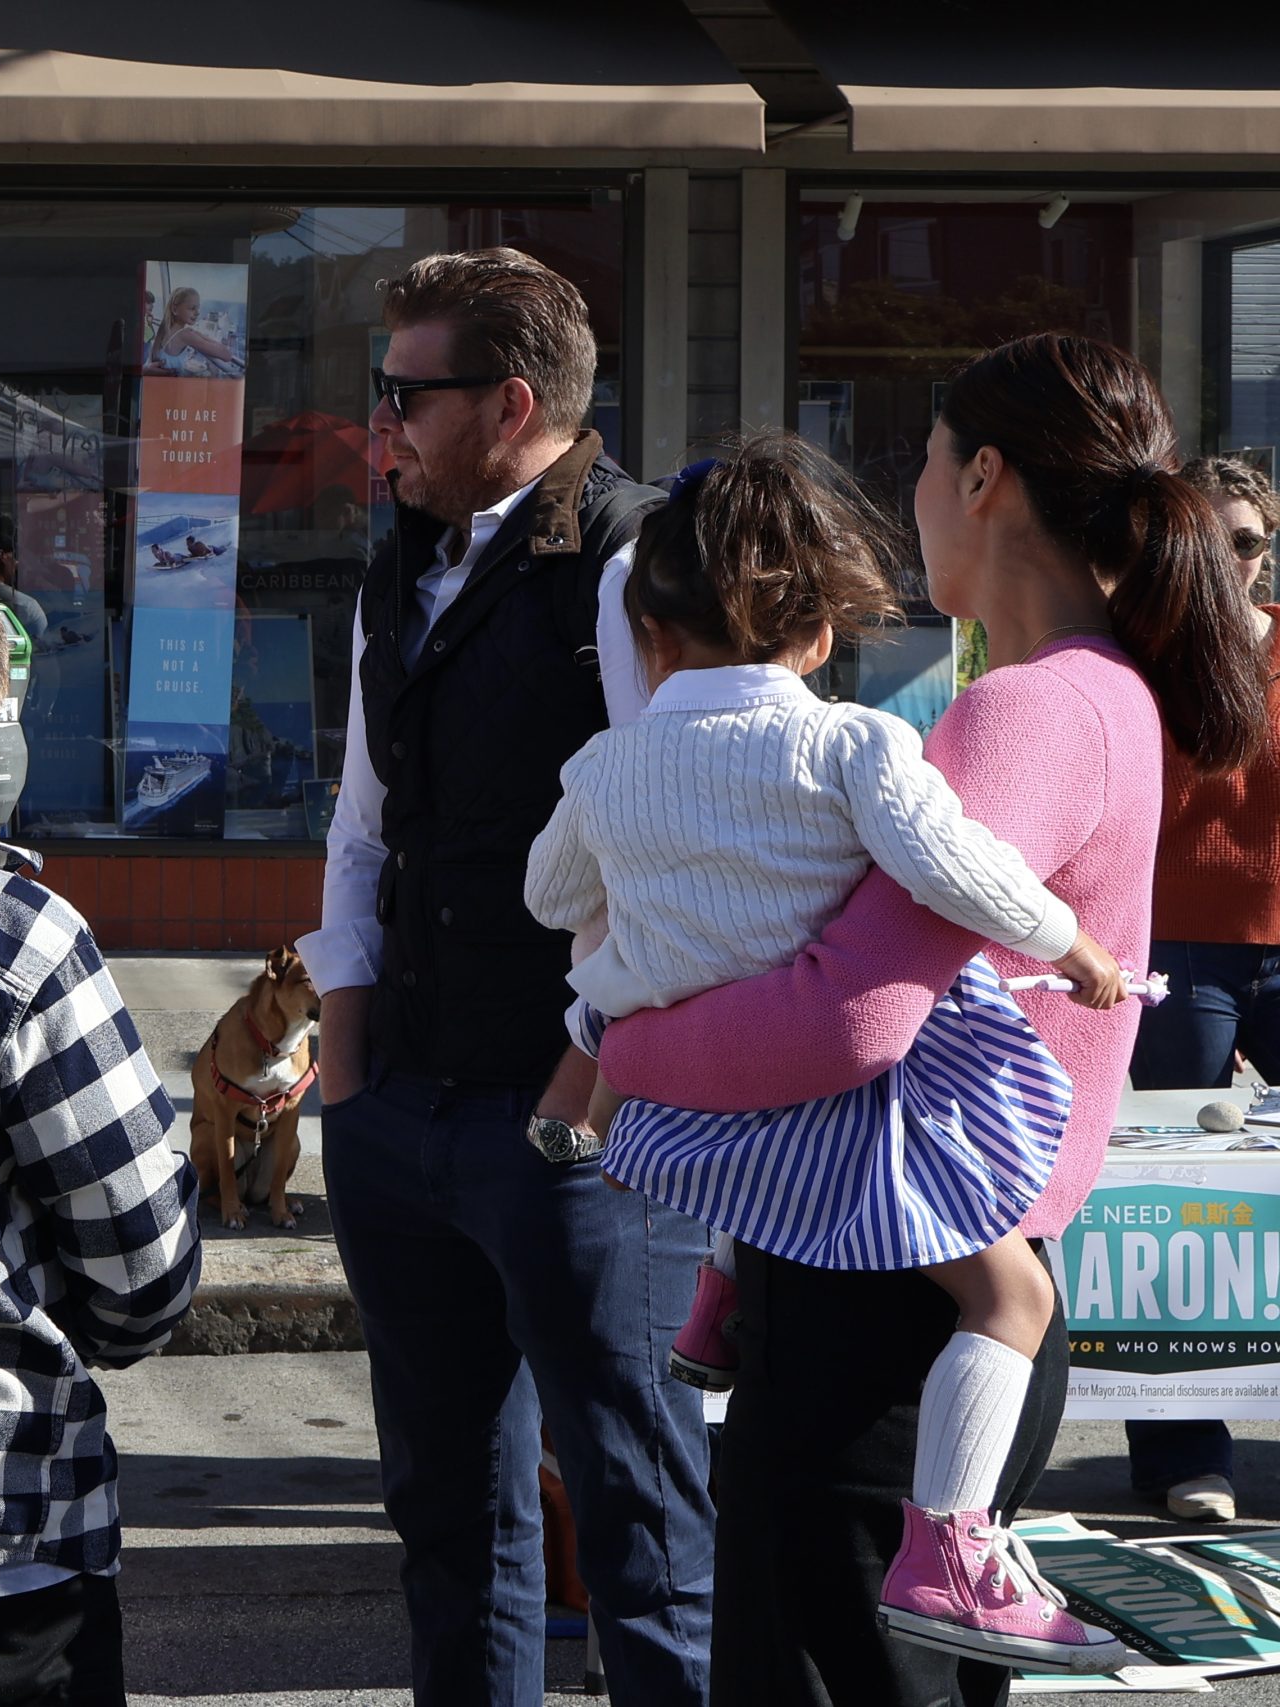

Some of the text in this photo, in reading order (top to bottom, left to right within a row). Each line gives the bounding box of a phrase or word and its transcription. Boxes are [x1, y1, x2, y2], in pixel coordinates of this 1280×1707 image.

[165, 408, 217, 422] YOU ARE
[172, 430, 208, 443] NOT A
[162, 450, 217, 464] TOURIST.
[241, 574, 355, 589] CARIBBEAN
[159, 638, 205, 652] THIS IS
[163, 660, 199, 673] NOT A
[156, 680, 204, 694] CRUISE.
[1070, 1205, 1172, 1225] E NEED
[1180, 1201, 1254, 1226] 佩斯金
[1068, 1341, 1105, 1353] YOR
[1116, 1341, 1159, 1353] WHO
[1169, 1341, 1237, 1353] KNOWS
[1077, 1384, 1089, 1397] for
[1090, 1384, 1117, 1399] Mayor
[1117, 1385, 1139, 1397] 2024.
[1140, 1383, 1175, 1397] Financial
[1176, 1383, 1219, 1397] disclosures
[1220, 1387, 1233, 1397] are
[1235, 1383, 1269, 1397] available
[1270, 1385, 1279, 1397] at
[1117, 1555, 1202, 1593] WE NEED
[1035, 1552, 1253, 1645] AARON!
[1071, 1599, 1160, 1653] KNOWS HOW
